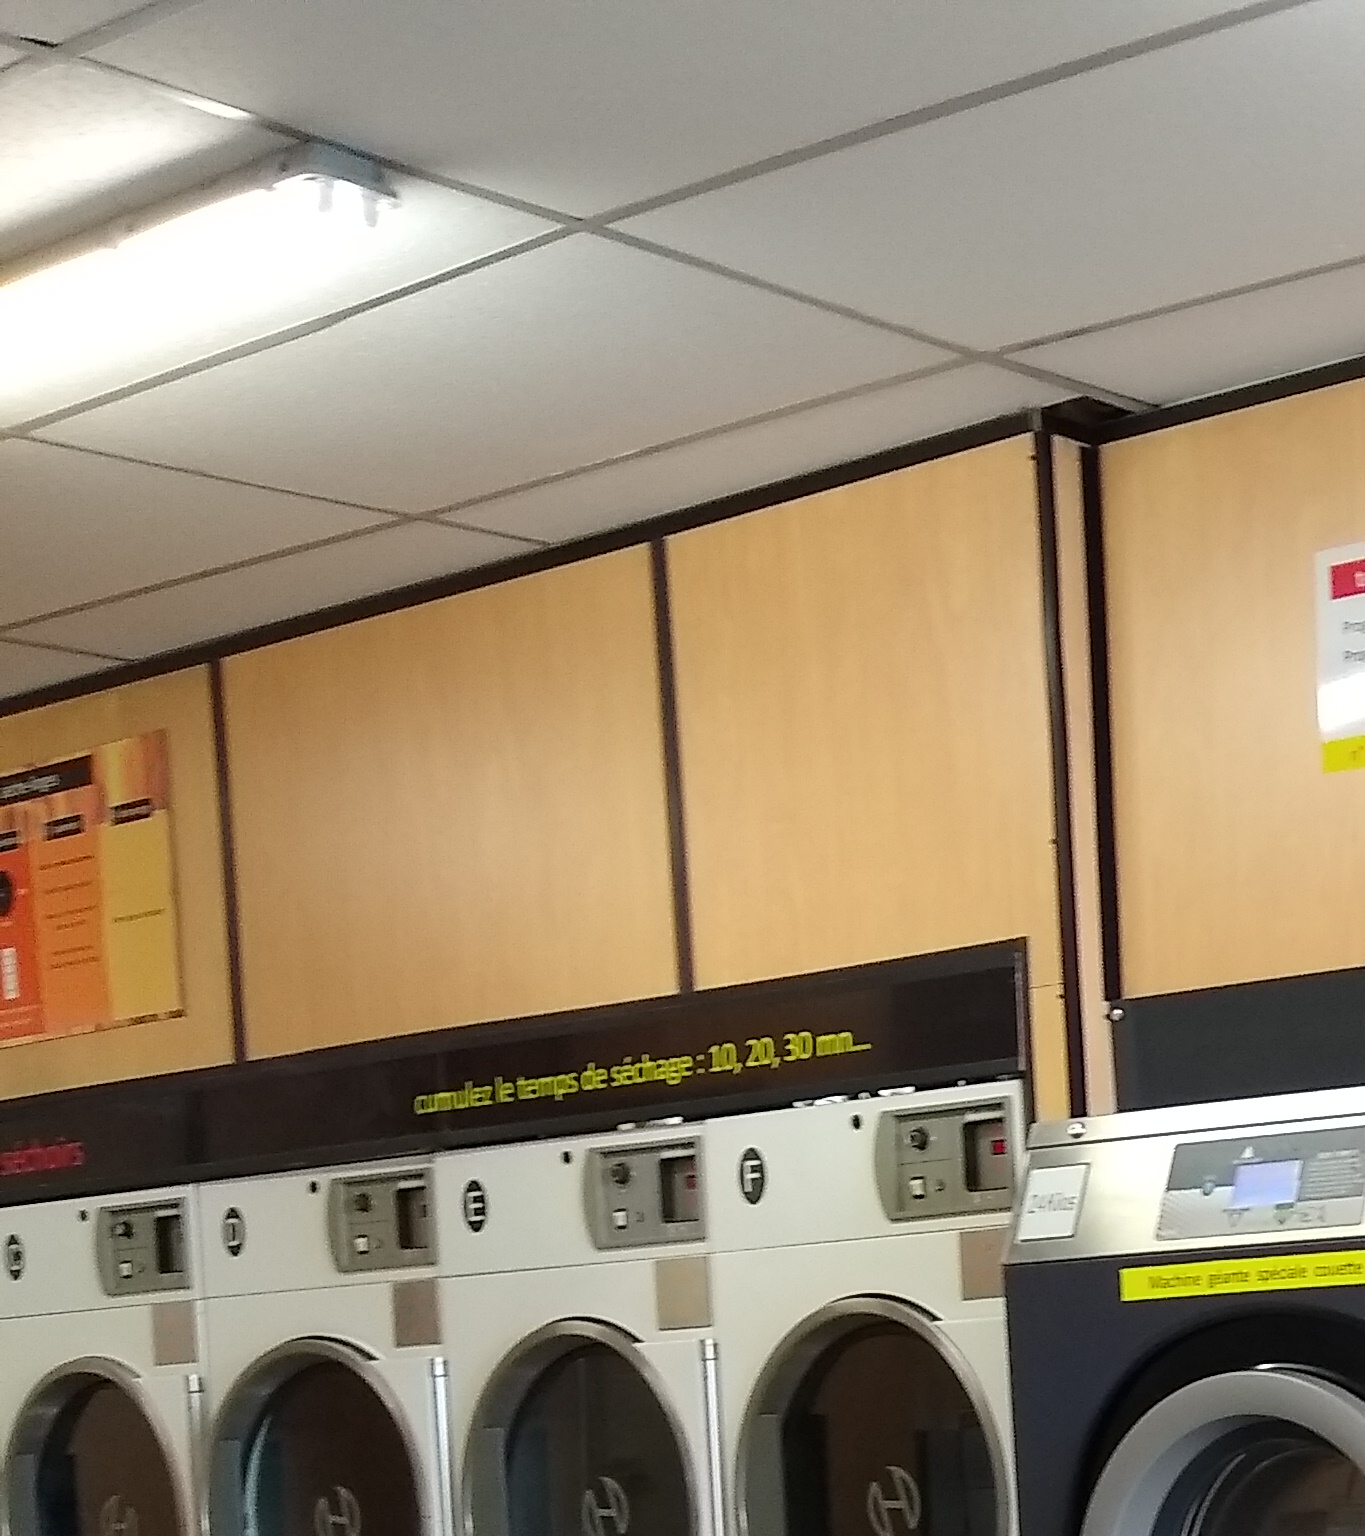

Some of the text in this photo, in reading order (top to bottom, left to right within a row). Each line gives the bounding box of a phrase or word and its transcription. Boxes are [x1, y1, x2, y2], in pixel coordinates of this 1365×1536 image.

[413, 1081, 493, 1115] cumulez
[494, 1076, 515, 1103] le
[516, 1072, 579, 1101] temps
[580, 1062, 608, 1092] de
[610, 1053, 694, 1087] séchage
[707, 1042, 743, 1075] 10,
[745, 1037, 781, 1069] 20,
[783, 1031, 813, 1062] 30
[1148, 1261, 1364, 1290] Machine géante spéciale couette
